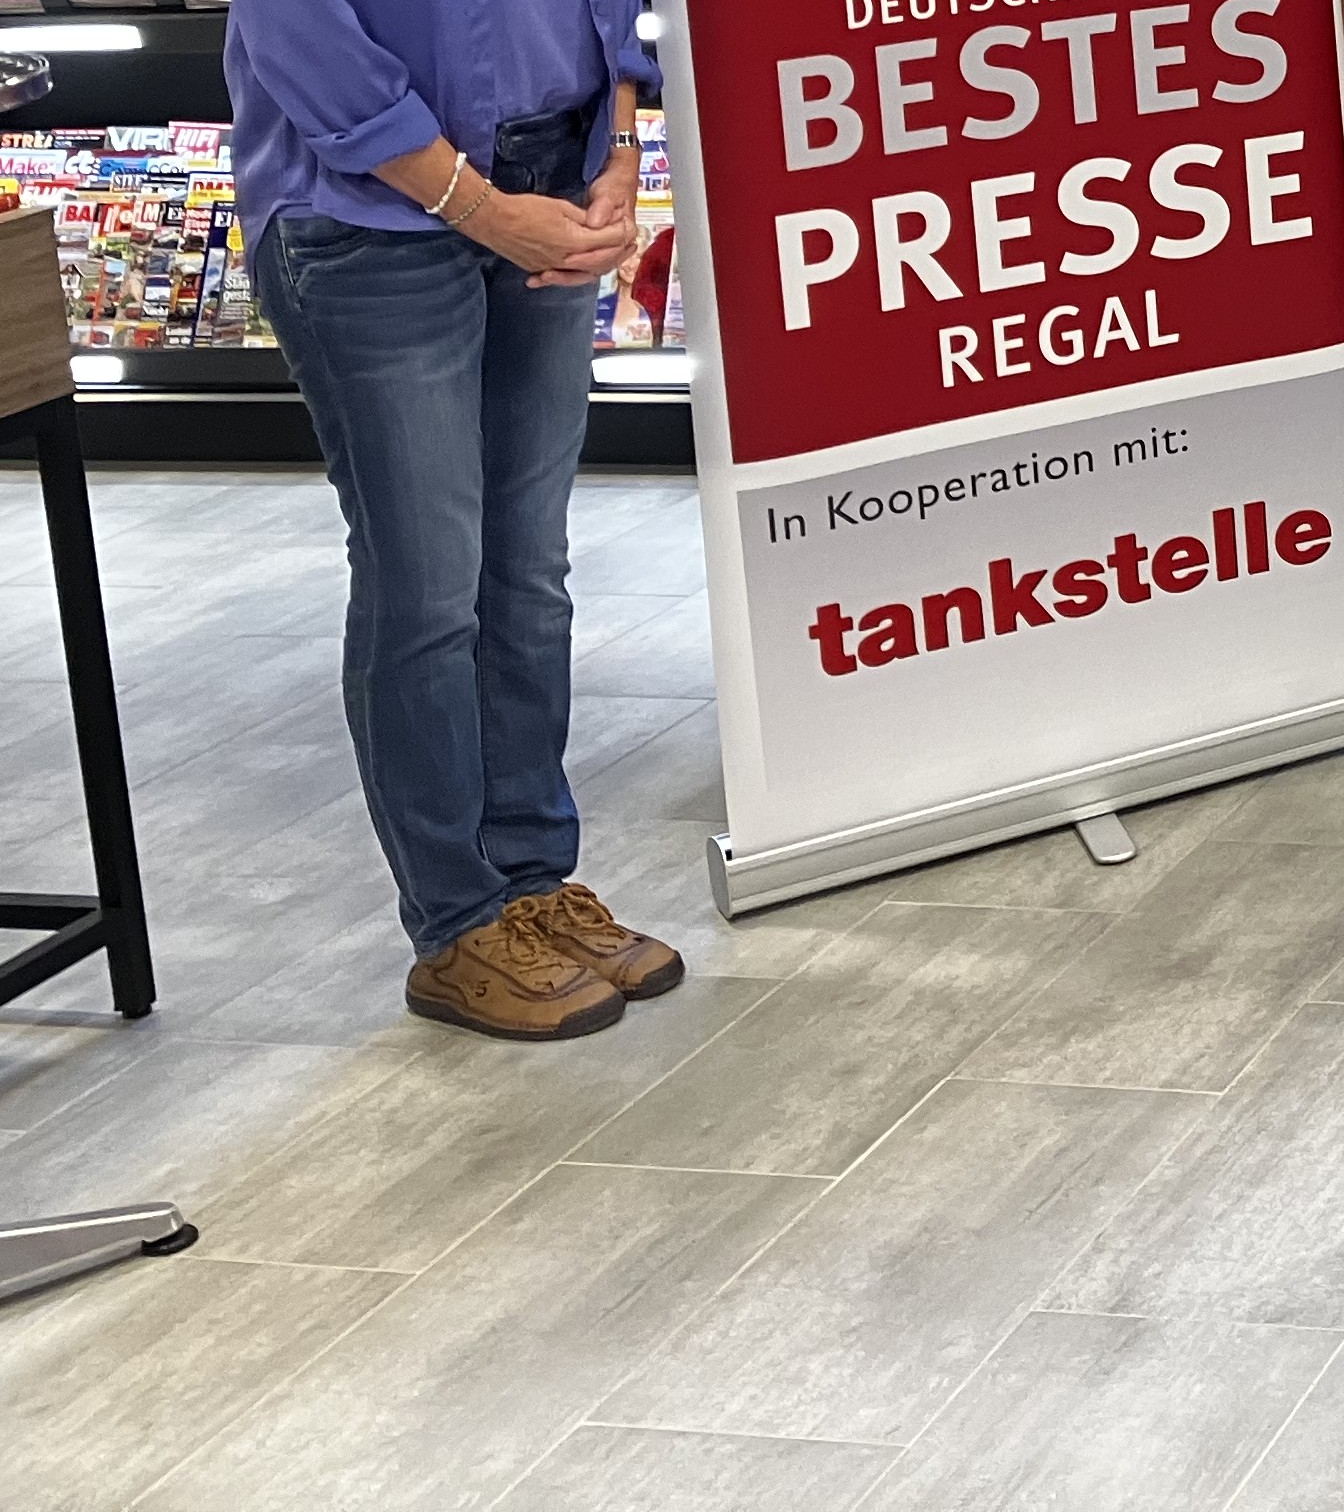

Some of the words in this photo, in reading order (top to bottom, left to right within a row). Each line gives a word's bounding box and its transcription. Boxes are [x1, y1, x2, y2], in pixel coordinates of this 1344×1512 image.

[774, 130, 1314, 333] PRESSE
[938, 289, 1180, 389] REGAL
[766, 507, 808, 544] In
[827, 442, 1096, 531] Kooperation
[1112, 425, 1190, 464] mit:
[808, 500, 1333, 678] tankstelle
